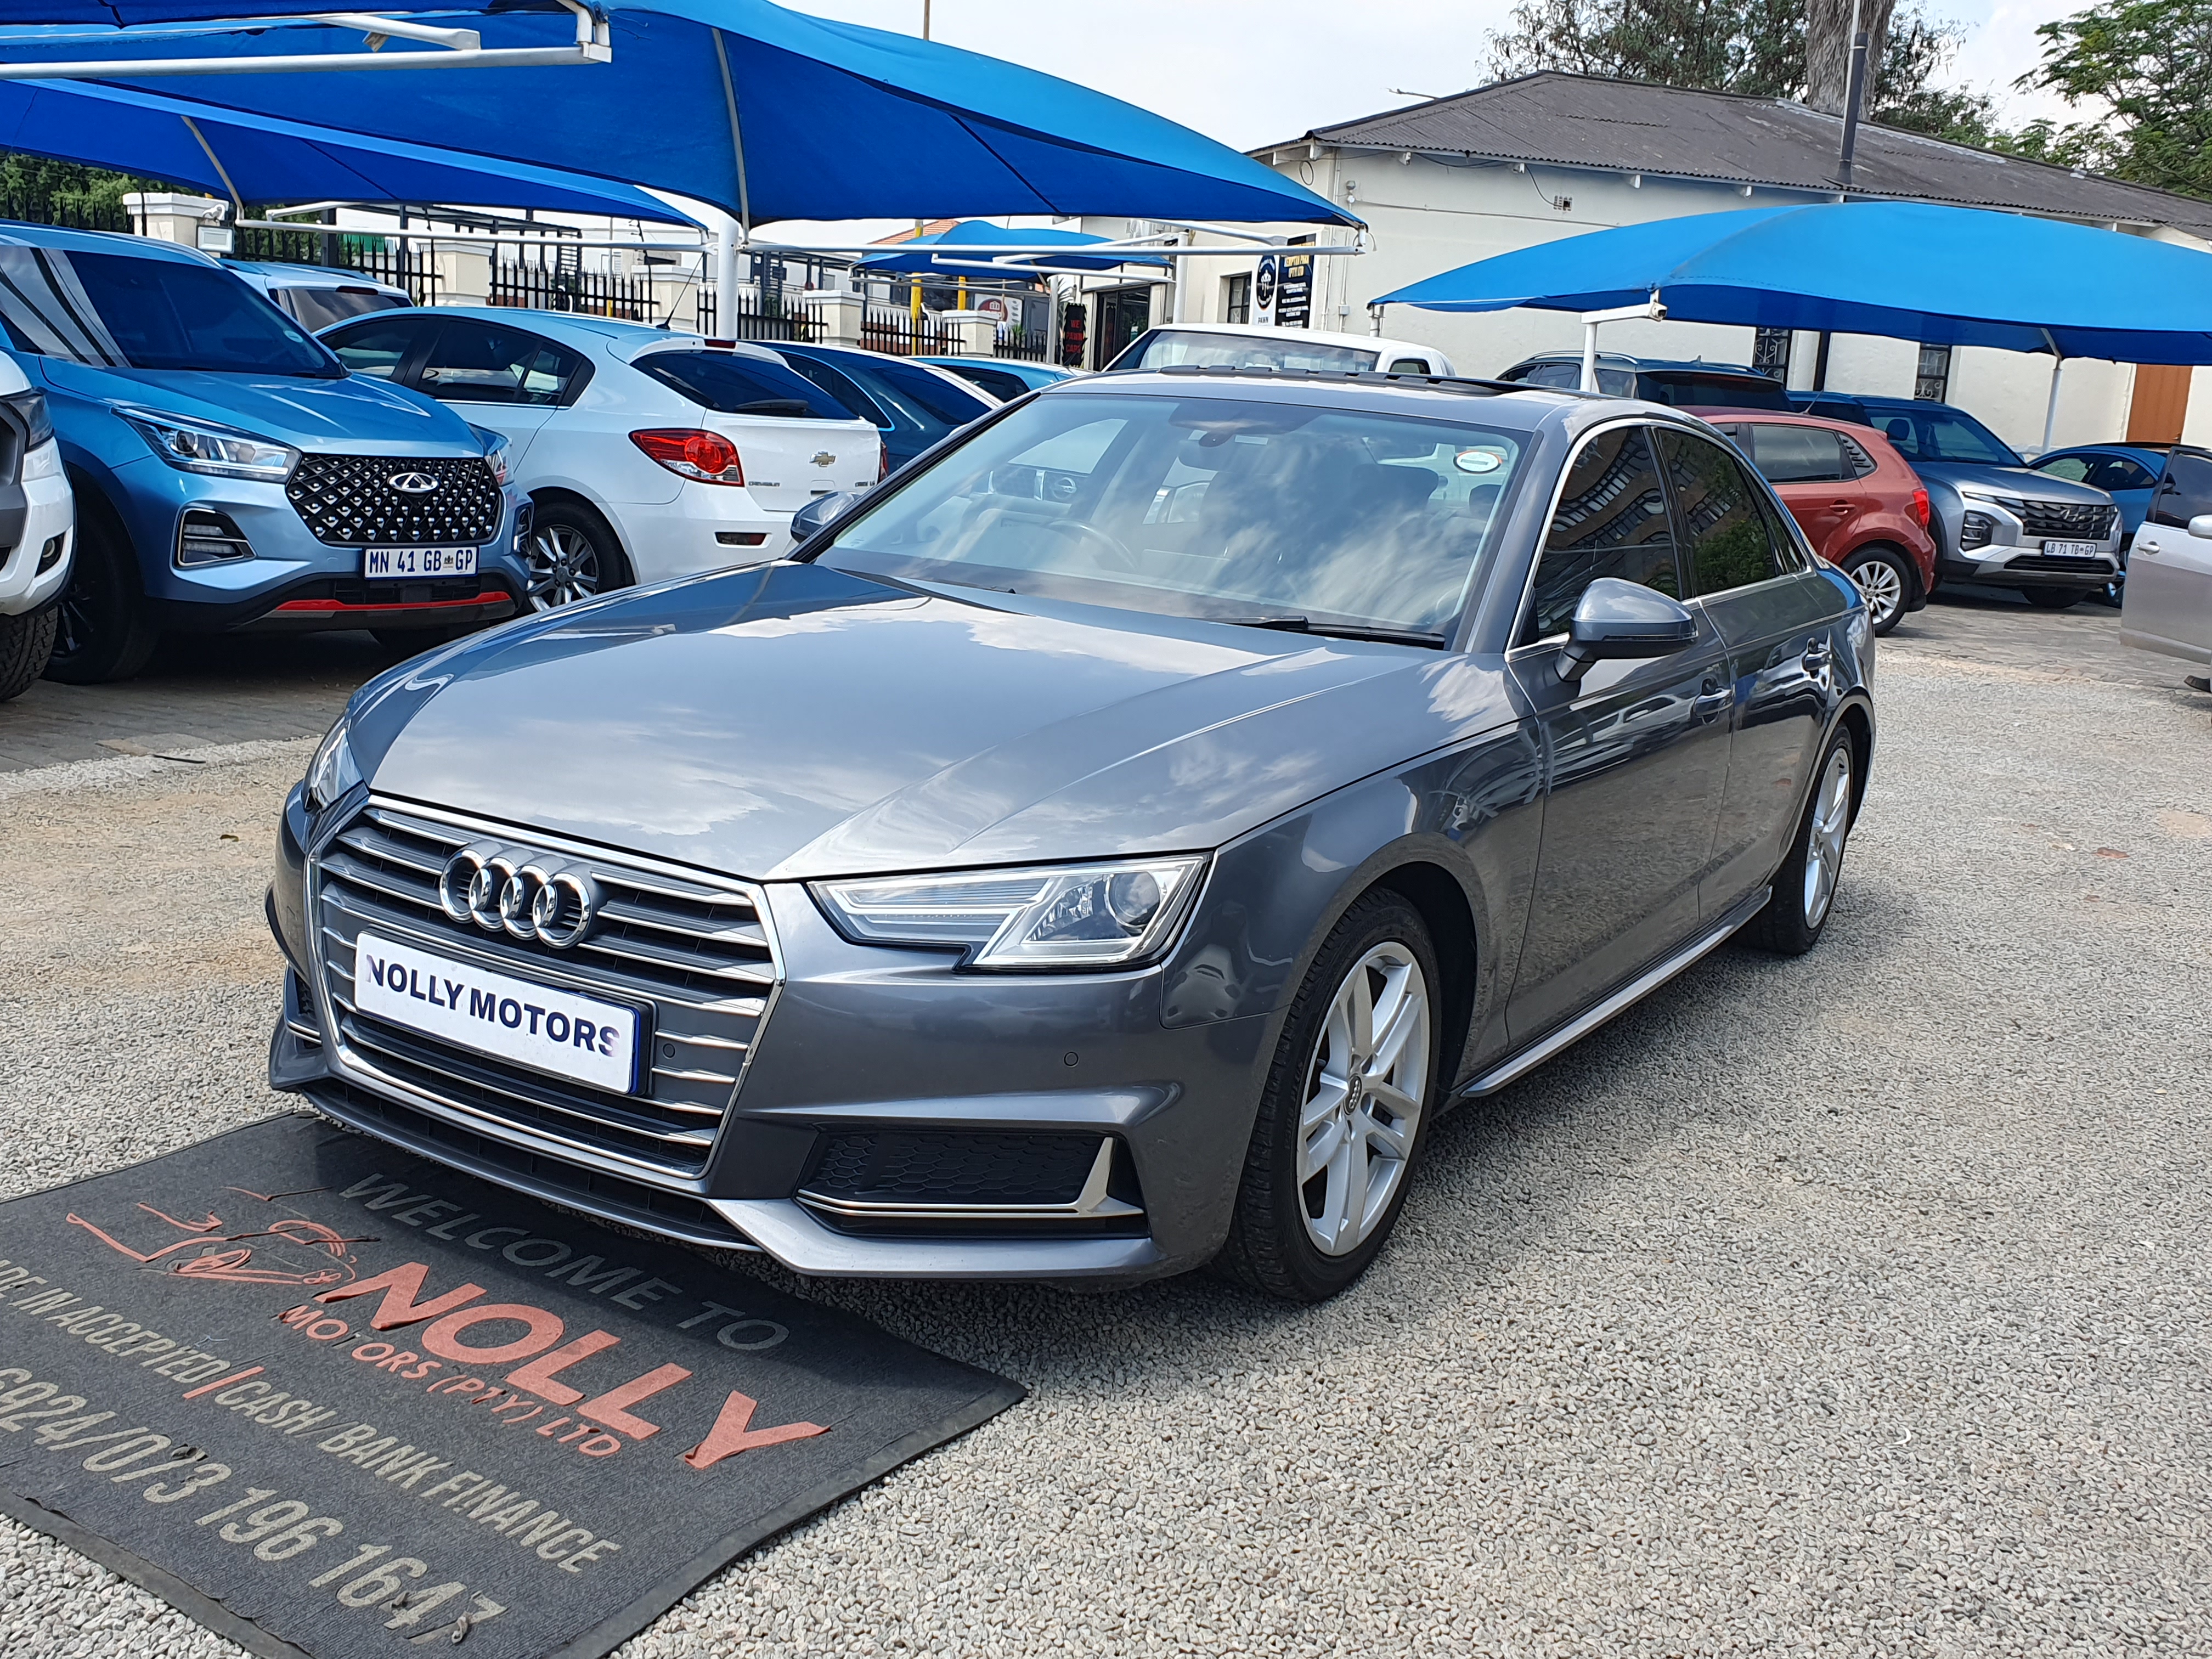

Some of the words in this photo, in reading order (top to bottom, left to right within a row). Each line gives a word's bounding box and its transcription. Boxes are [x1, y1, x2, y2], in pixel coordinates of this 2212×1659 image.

[1066, 332, 1084, 340] PAWN
[1070, 320, 1081, 328] WE
[369, 551, 389, 573] MN
[397, 551, 415, 572] 41
[424, 550, 442, 572] GB
[455, 550, 473, 571] GP
[2046, 543, 2056, 553] LB
[2058, 544, 2067, 554] 71
[2071, 544, 2079, 555] TB
[2085, 545, 2094, 555] GP
[365, 953, 465, 1010] NOLLY
[470, 988, 620, 1057] MOTORS
[338, 1172, 684, 1310] WELCOME
[676, 1300, 790, 1350] TO
[8, 1288, 82, 1315] IN
[44, 1306, 231, 1383] ACCEPTED
[313, 1261, 831, 1469] NOLLY
[426, 1374, 543, 1424] (PTY)
[535, 1417, 622, 1457] LTD
[420, 1470, 626, 1573] FINANCE
[195, 1487, 343, 1561] 196
[308, 1544, 507, 1644] 1647
